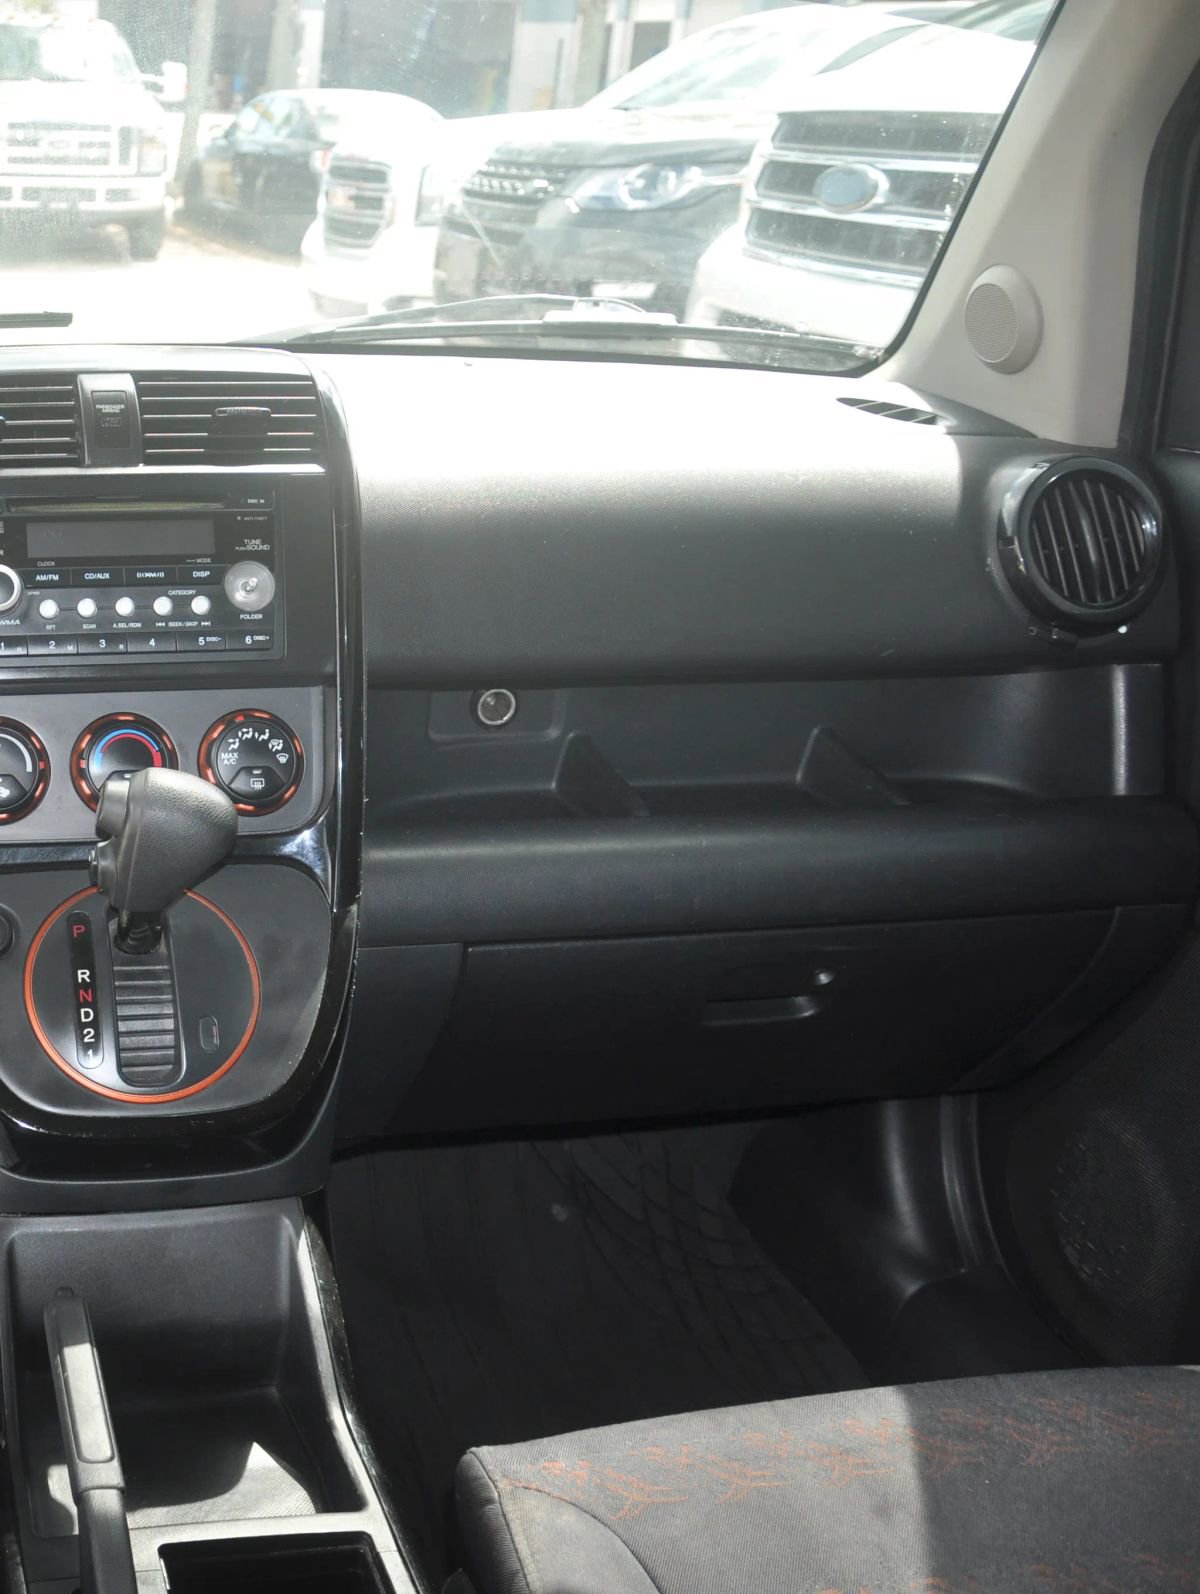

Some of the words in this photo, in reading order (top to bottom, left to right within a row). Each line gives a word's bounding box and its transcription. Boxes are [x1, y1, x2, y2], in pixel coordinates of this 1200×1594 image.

[99, 639, 106, 648] 3
[149, 638, 156, 647] 4
[198, 636, 205, 645] 5
[245, 635, 252, 644] 6
[0, 642, 5, 651] 1
[48, 640, 56, 649] 2
[222, 758, 237, 766] A/C
[73, 925, 86, 938] P
[77, 969, 91, 983] R
[79, 989, 93, 1002] N
[80, 1008, 94, 1022] D
[83, 1028, 95, 1042] 2
[87, 1049, 94, 1059] 1
